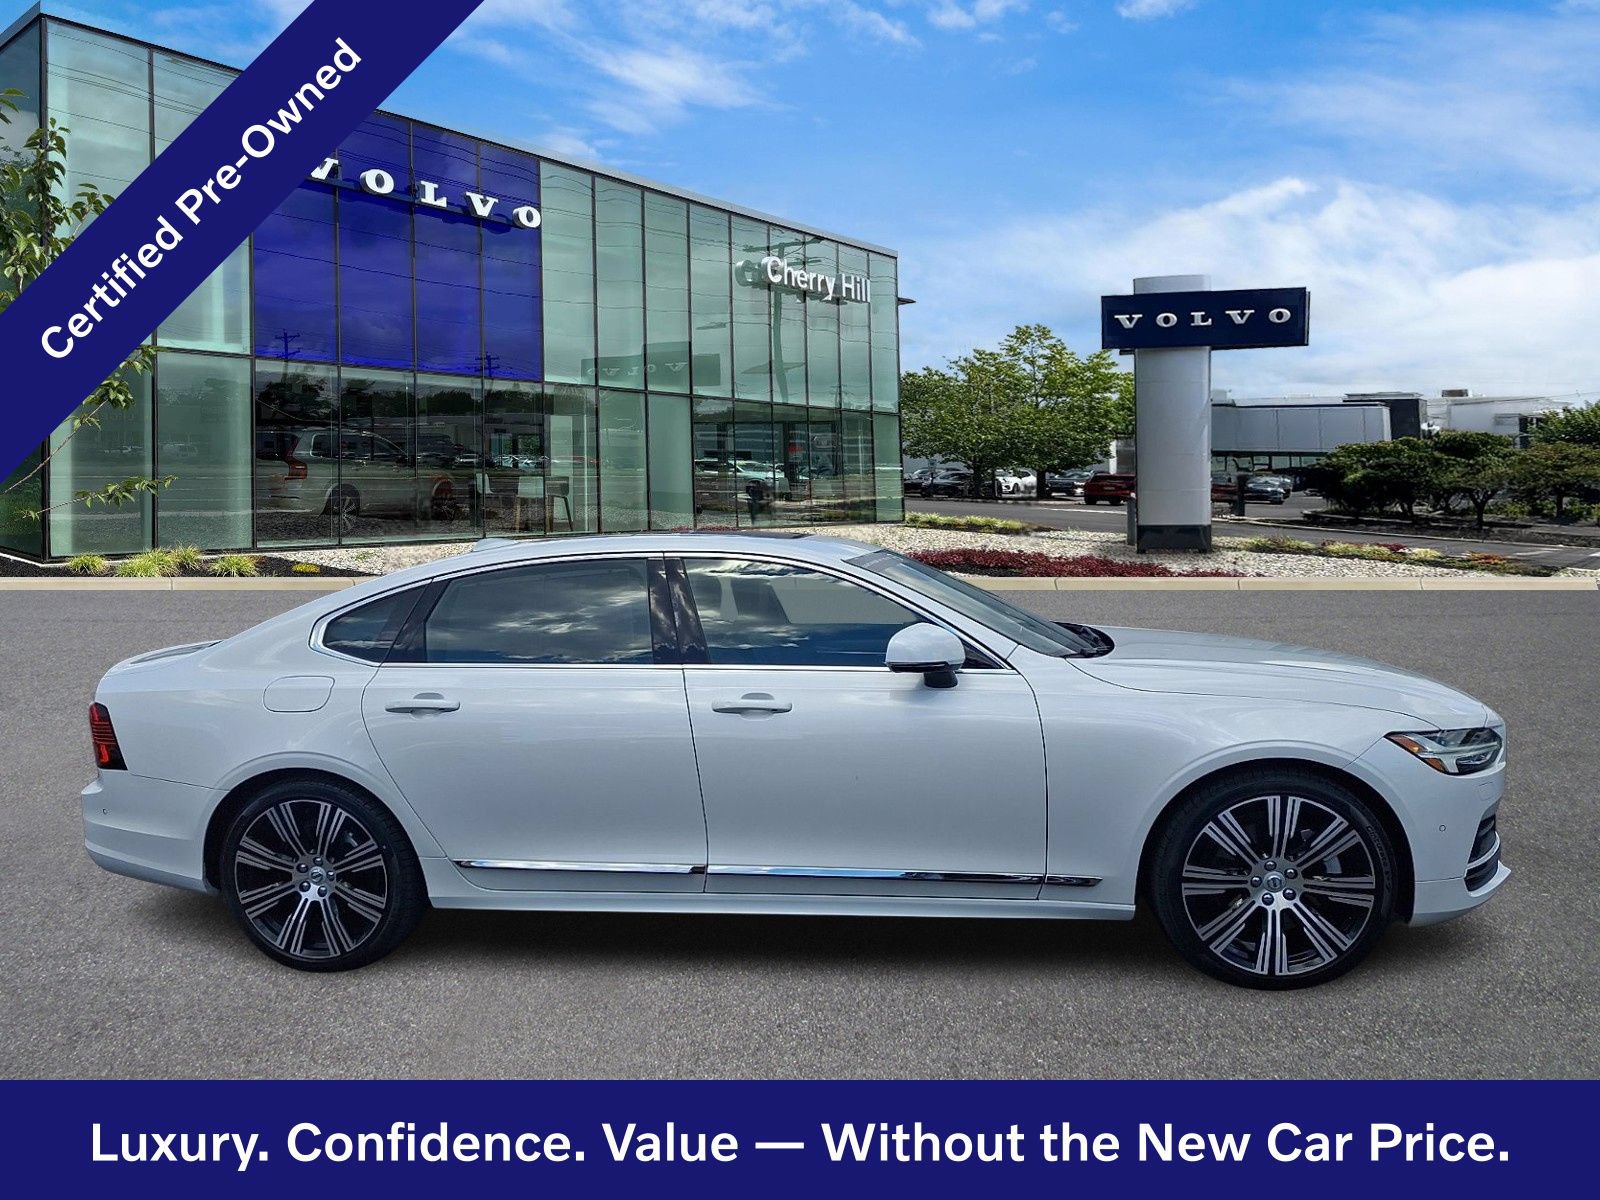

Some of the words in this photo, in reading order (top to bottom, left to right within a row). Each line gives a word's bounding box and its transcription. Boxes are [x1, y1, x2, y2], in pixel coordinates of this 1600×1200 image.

[763, 256, 835, 301] Cherry
[842, 273, 871, 303] Hill
[1114, 307, 1291, 329] VOLVO
